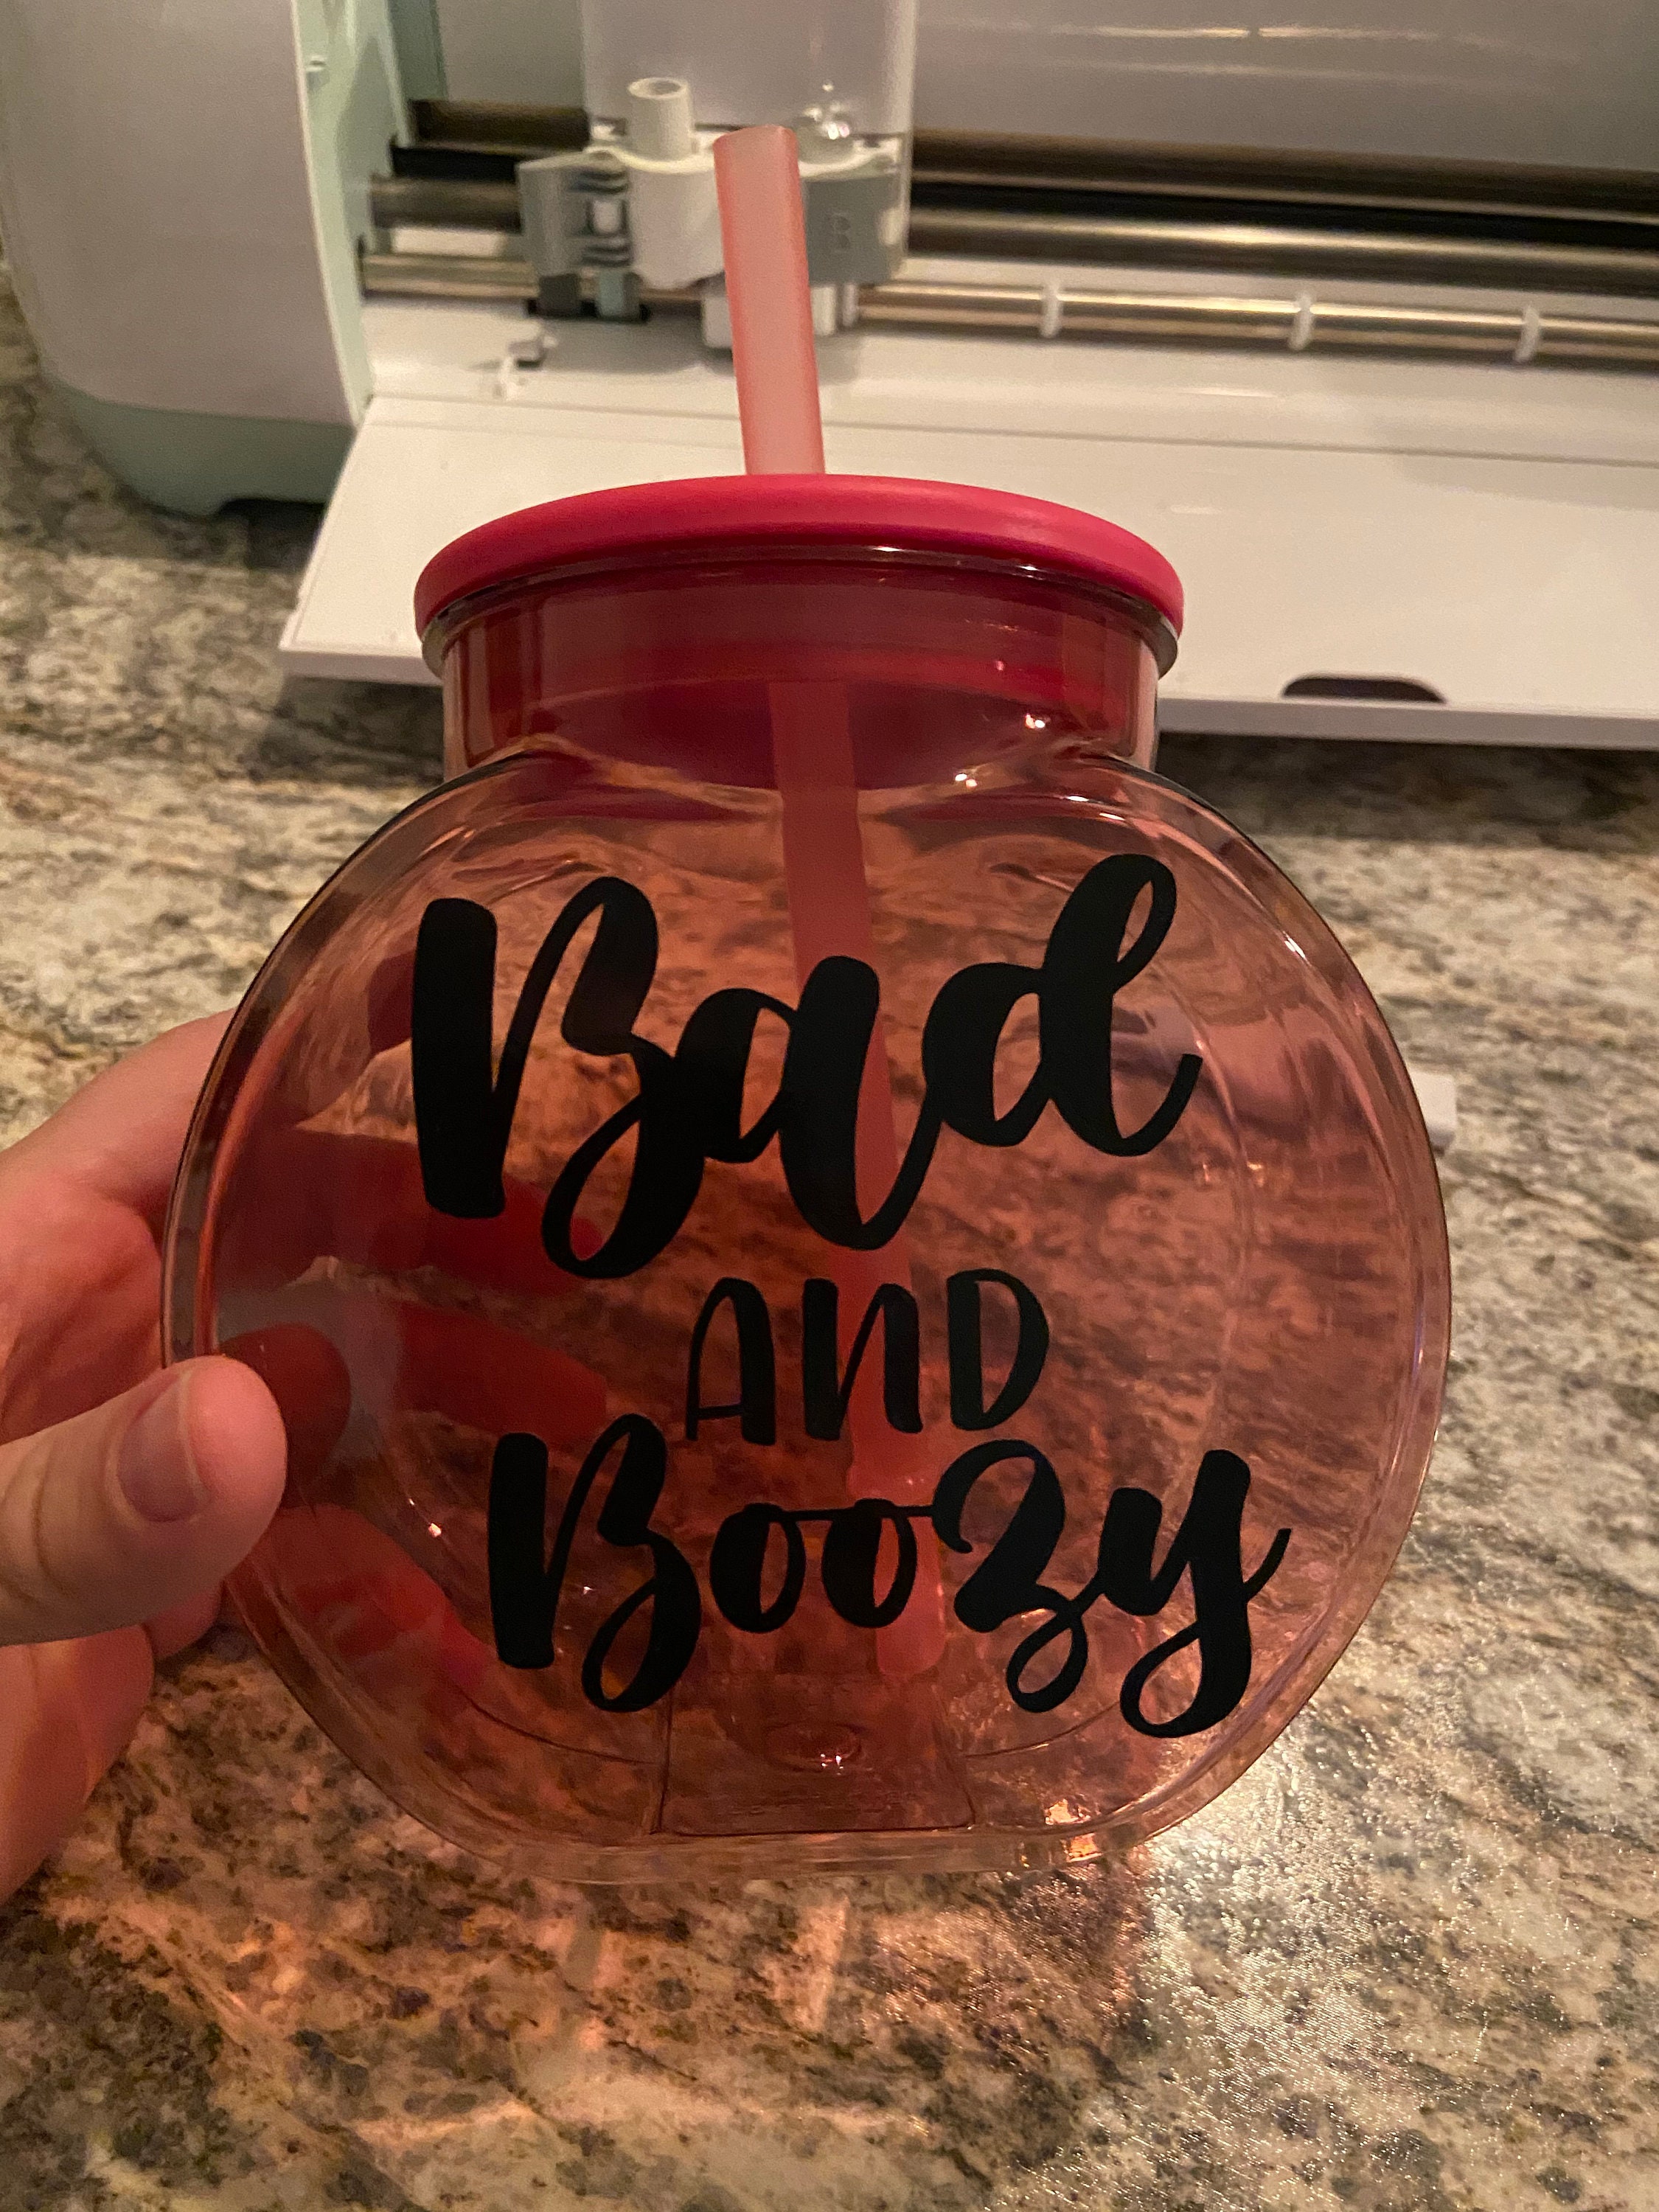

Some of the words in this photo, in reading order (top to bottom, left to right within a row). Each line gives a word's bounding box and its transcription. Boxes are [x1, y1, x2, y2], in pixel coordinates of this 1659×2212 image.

[411, 853, 1202, 1279] Bad
[686, 1269, 1050, 1446] AND
[487, 1413, 1292, 1739] Boozy
